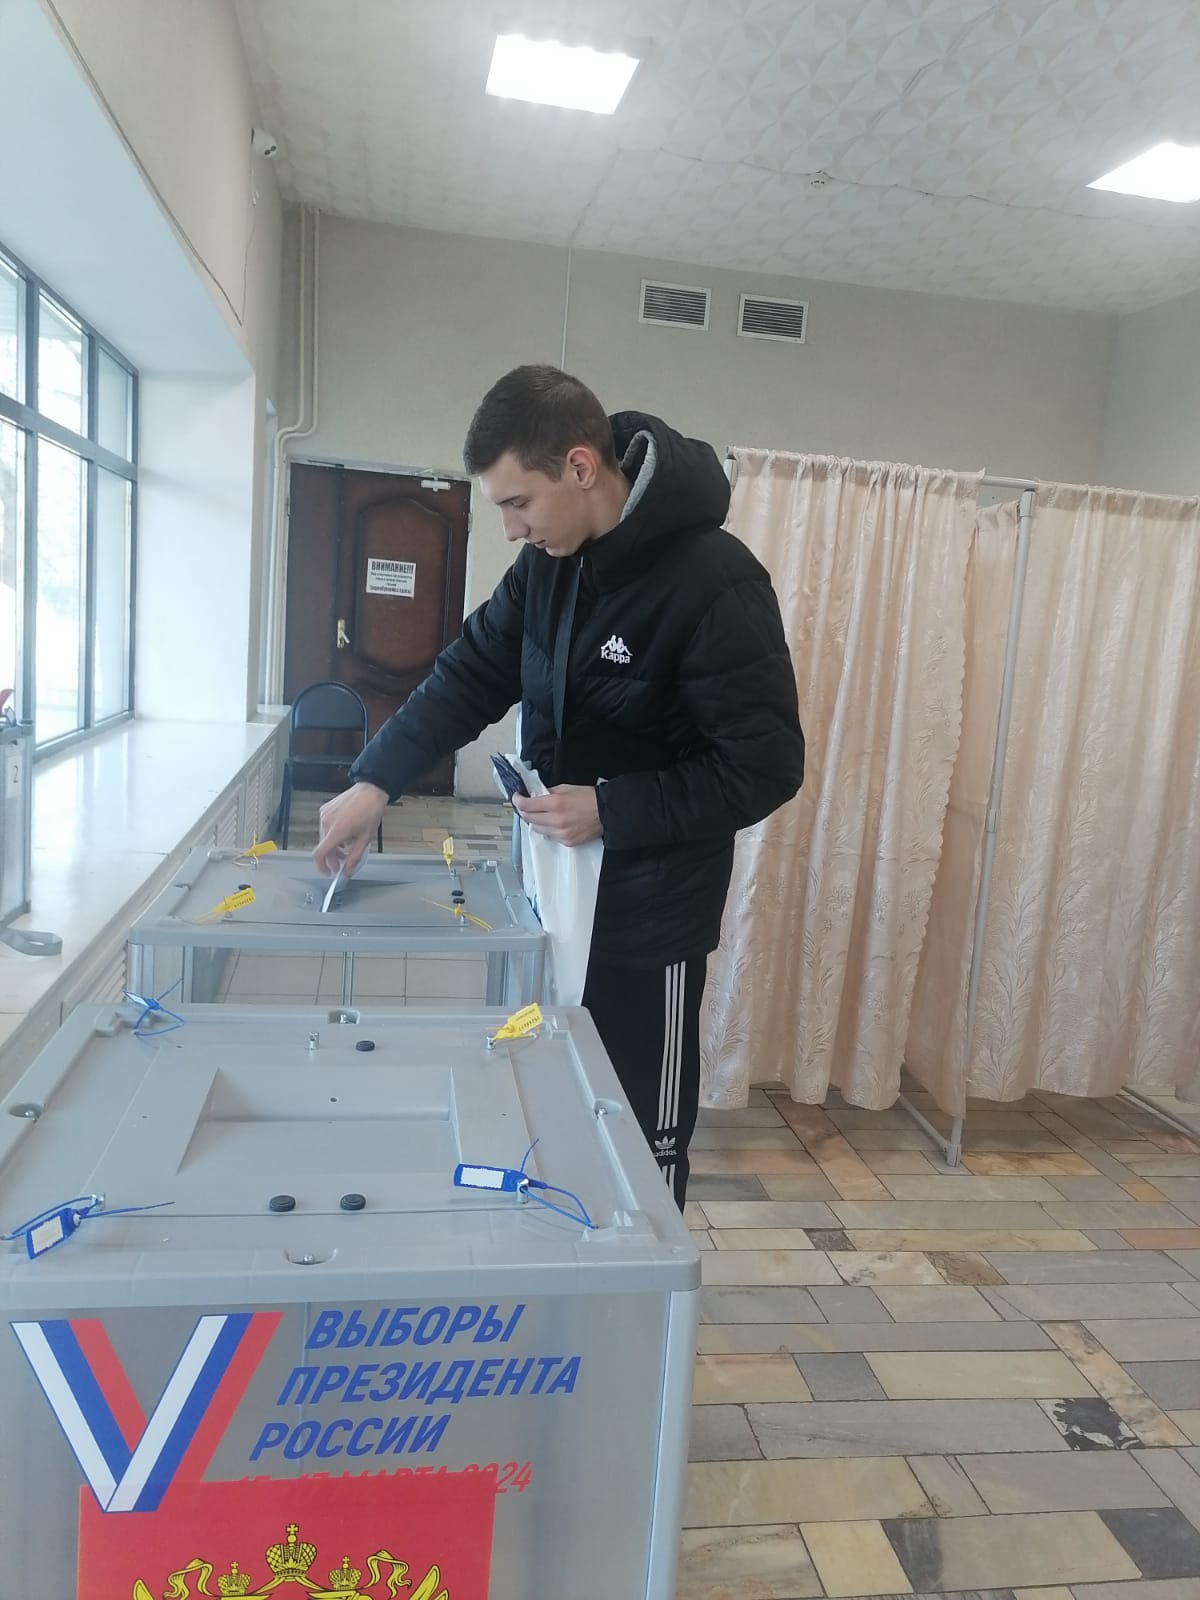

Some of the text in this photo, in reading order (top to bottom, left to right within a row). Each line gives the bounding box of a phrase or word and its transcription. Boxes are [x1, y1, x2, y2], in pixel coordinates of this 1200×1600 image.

[601, 648, 631, 664] Kappa
[304, 1304, 526, 1350] ВЫБОРЫ
[276, 1356, 581, 1406] ПРЕЗИДЕНТА
[249, 1414, 452, 1461] РОССИИ
